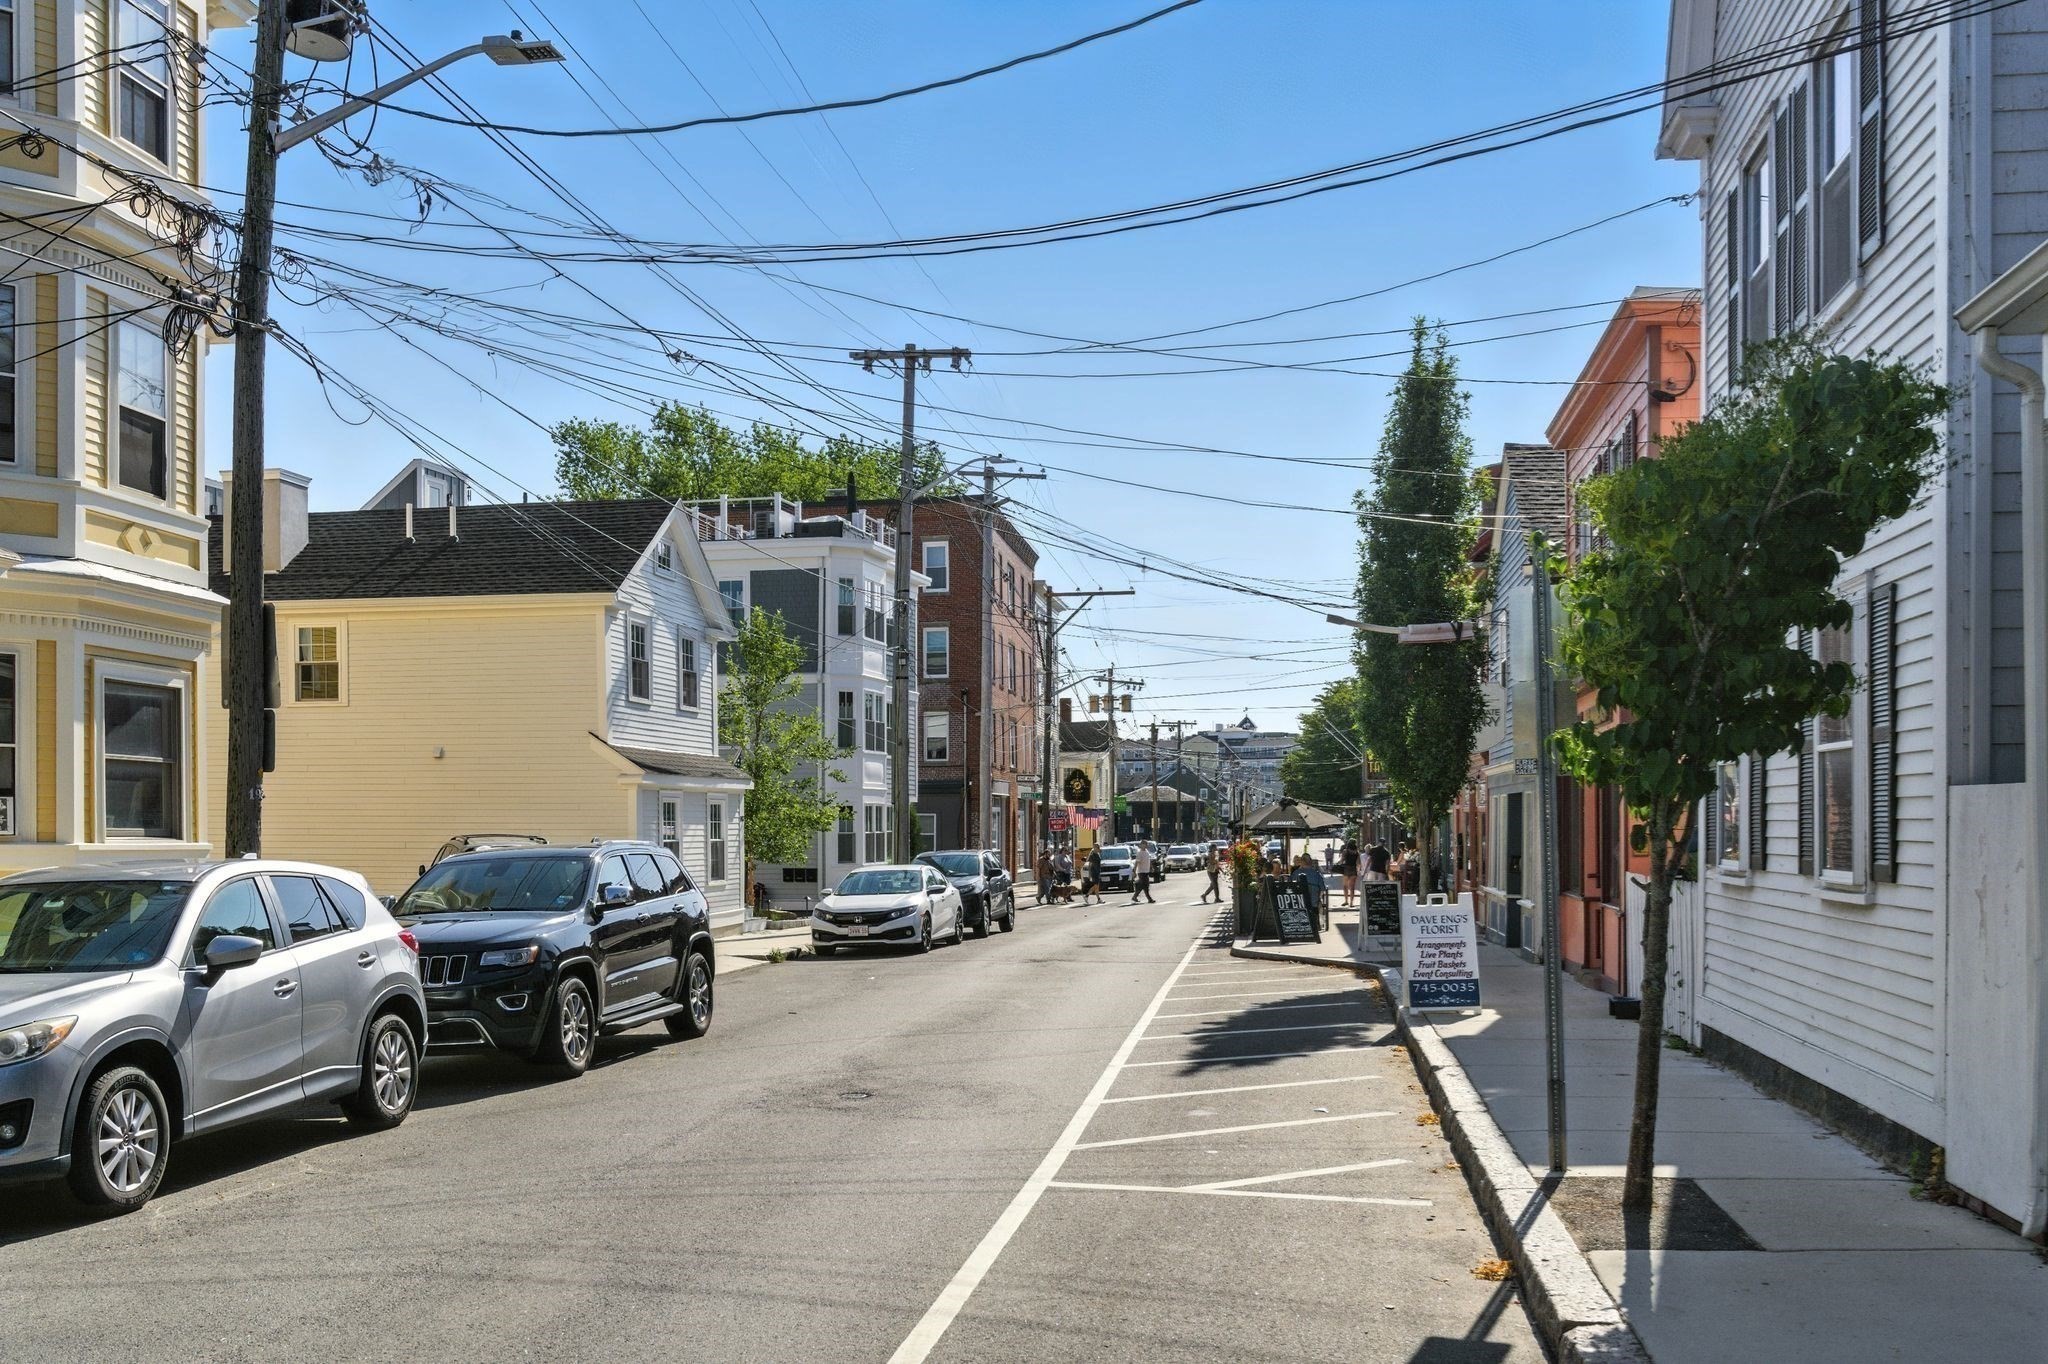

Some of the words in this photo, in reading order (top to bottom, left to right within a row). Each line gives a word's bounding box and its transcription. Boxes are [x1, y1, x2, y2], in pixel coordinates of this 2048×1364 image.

[1277, 894, 1305, 909] OPEN
[1410, 915, 1437, 925] DAVE
[1440, 914, 1468, 924] ENG'S
[1420, 924, 1459, 935] FLORIST
[1416, 940, 1466, 950] Arrangements
[1420, 951, 1437, 959] Live
[1438, 950, 1463, 960] Plants
[1418, 960, 1436, 969] Fruit
[1437, 960, 1466, 970] Baskets
[1412, 970, 1433, 979] Event
[1434, 969, 1473, 979] Consulting
[1413, 982, 1475, 993] 745-0035
[114, 1074, 136, 1090] GUIDE
